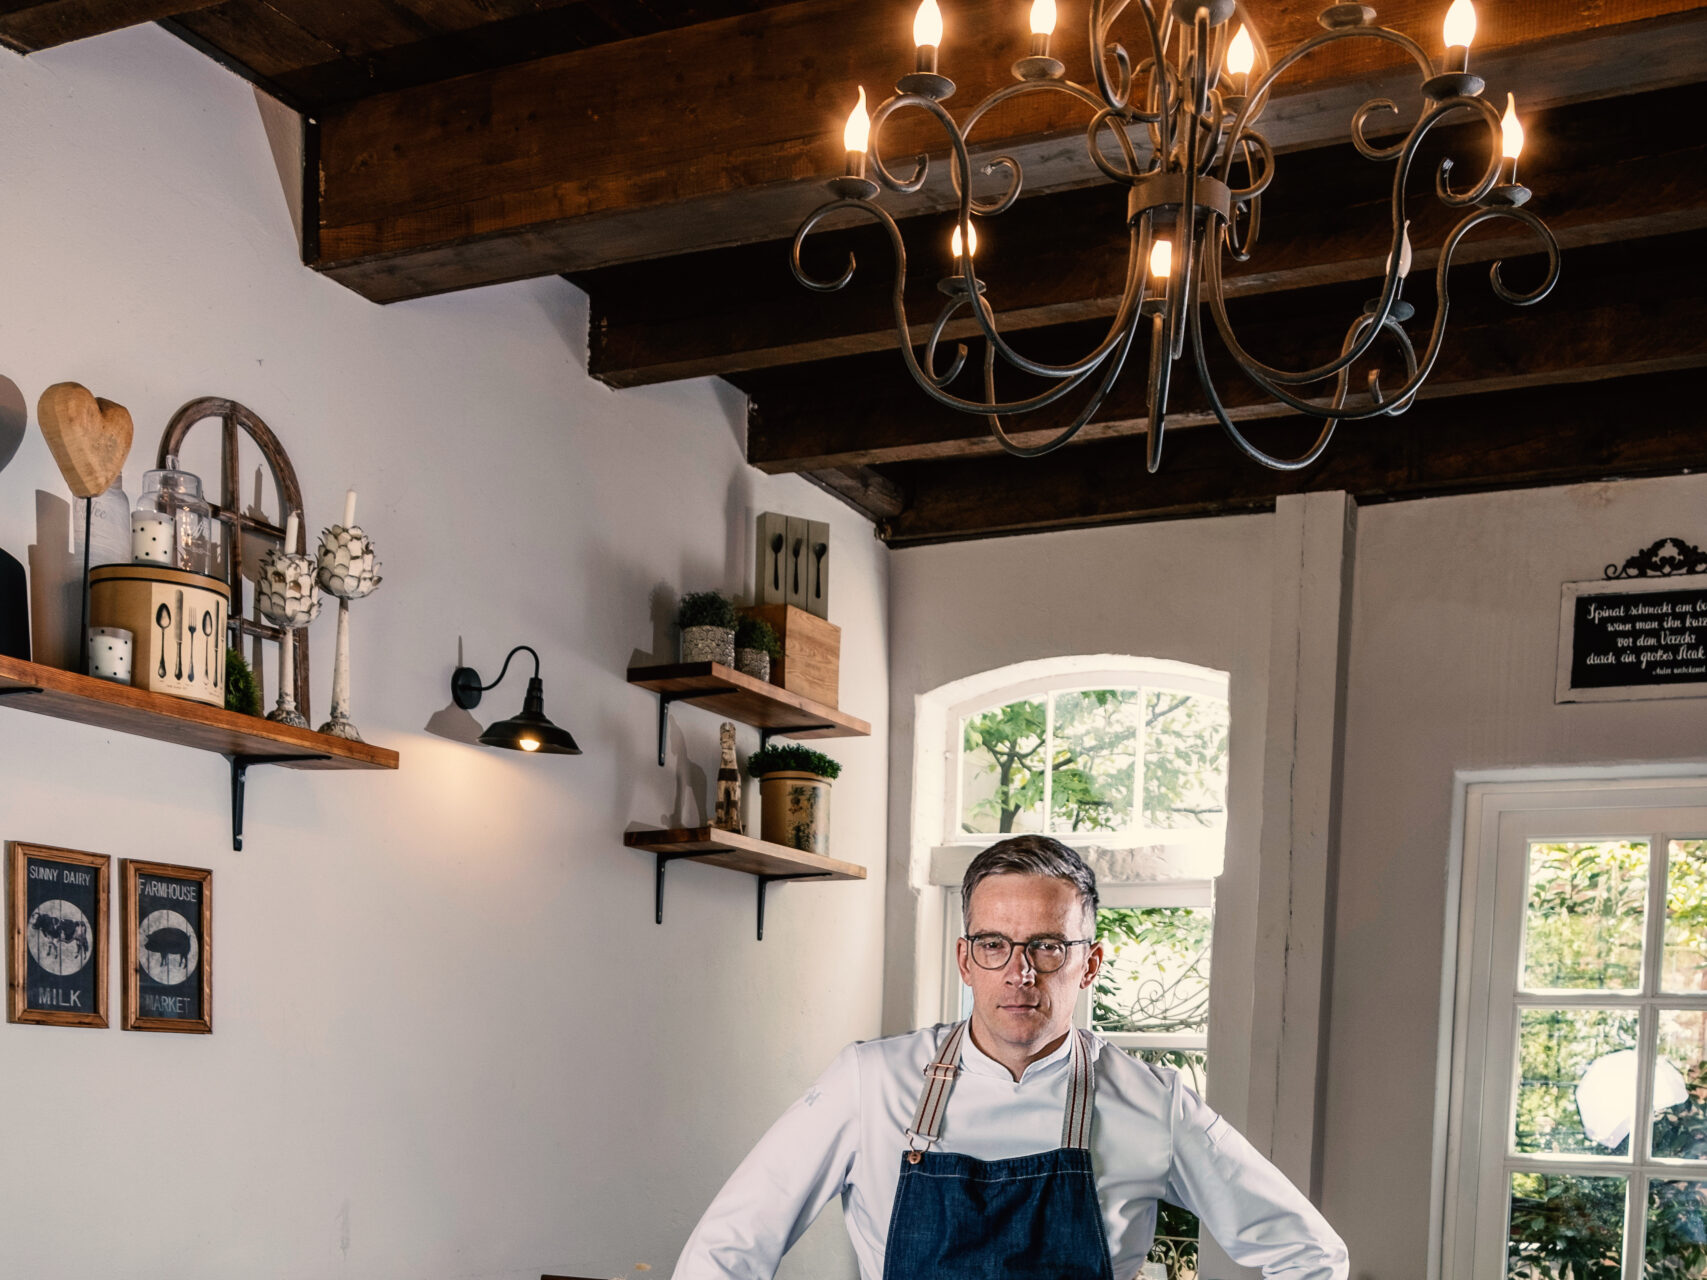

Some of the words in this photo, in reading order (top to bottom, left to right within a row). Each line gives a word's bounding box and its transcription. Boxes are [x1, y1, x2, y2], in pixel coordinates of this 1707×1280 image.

[1587, 602, 1625, 624] Spinat
[1628, 601, 1672, 615] schmeckt
[1675, 604, 1693, 613] am
[1606, 621, 1632, 632] wenn
[1635, 620, 1658, 630] man
[1663, 615, 1682, 629] ihn
[1616, 636, 1633, 648] vor
[1636, 634, 1658, 646] dem
[1660, 630, 1696, 645] Verzehr
[1586, 652, 1616, 665] durch
[1620, 650, 1637, 663] ein
[1640, 648, 1673, 670] großes
[1676, 644, 1706, 660] Steak
[29, 864, 60, 883] SUNNY
[63, 869, 91, 887] DAIRY
[138, 878, 197, 903] FARMHOUSE
[38, 987, 82, 1008] MILK
[144, 993, 191, 1014] MARKET
